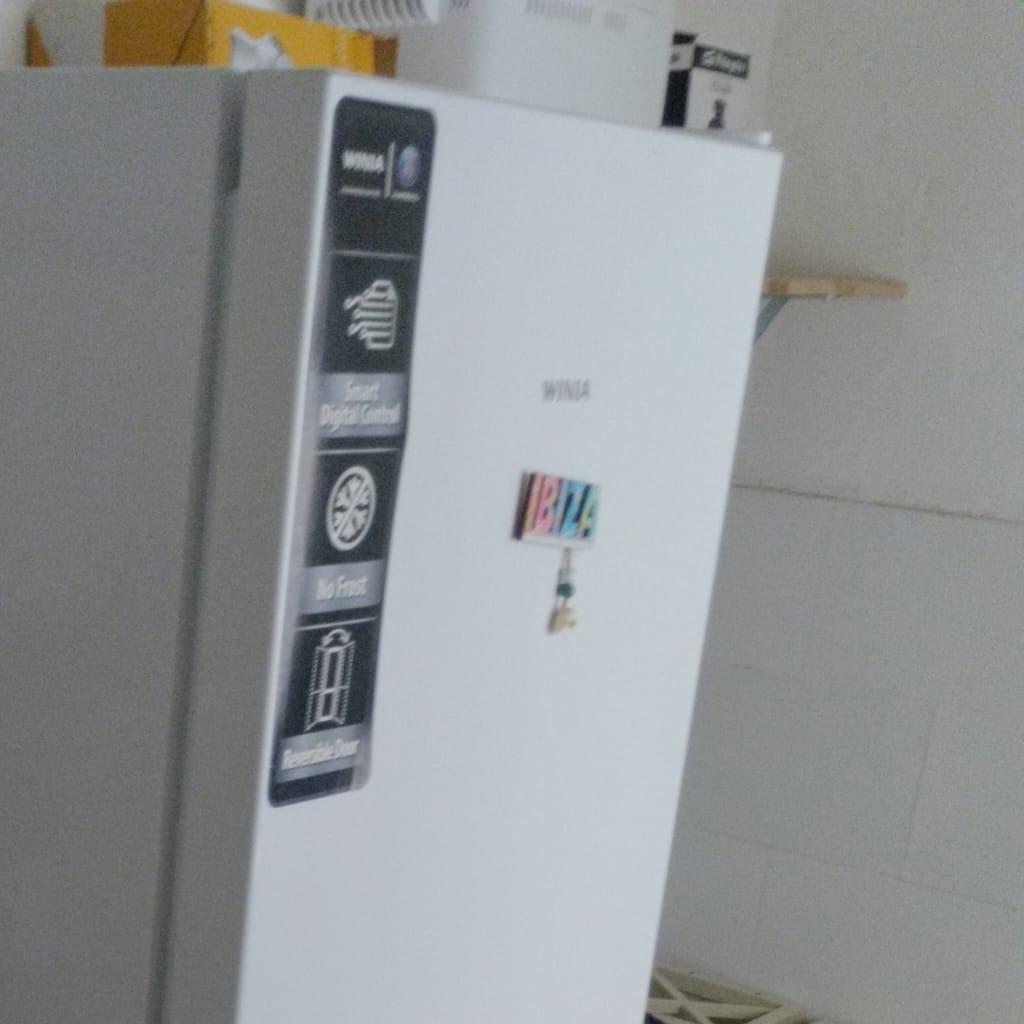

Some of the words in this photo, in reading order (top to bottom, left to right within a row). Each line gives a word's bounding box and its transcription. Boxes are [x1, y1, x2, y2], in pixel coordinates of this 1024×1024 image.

[344, 381, 381, 401] Smart
[542, 378, 591, 402] WINIA
[320, 402, 358, 432] Digital
[361, 401, 400, 425] Control
[316, 577, 335, 602] No
[336, 574, 368, 598] Frost
